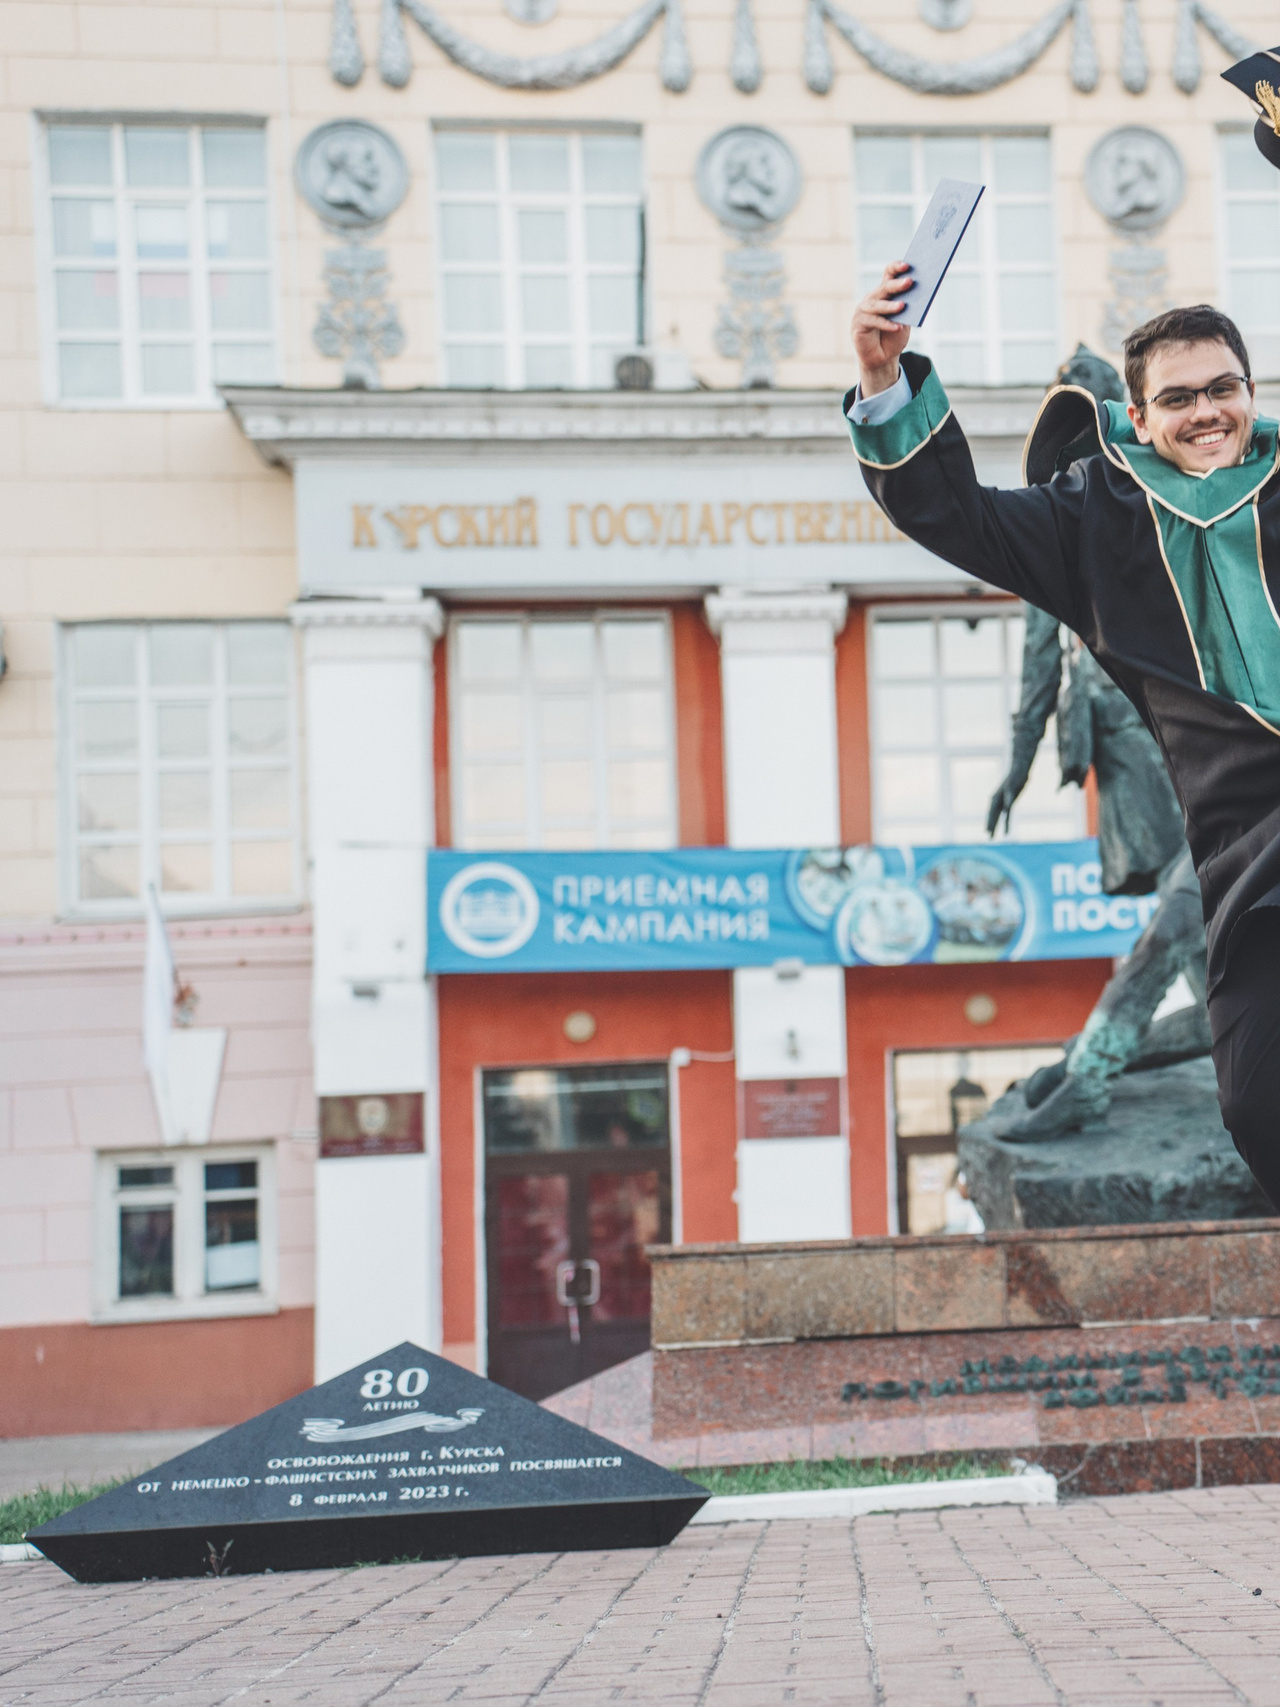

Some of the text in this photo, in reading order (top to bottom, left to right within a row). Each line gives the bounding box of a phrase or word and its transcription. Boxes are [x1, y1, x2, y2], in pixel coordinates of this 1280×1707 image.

[353, 496, 910, 548] КУРСКИЙ ГОСУДАРСТВЕНН
[1051, 861, 1103, 896] ПО
[553, 909, 770, 943] КАМПАНИЯ
[1052, 895, 1160, 932] ПОСТ
[360, 1367, 429, 1398] 80
[362, 1399, 420, 1412] ЛЕТИЮ
[267, 1452, 410, 1469] ОСВОБОЖДЕНИЯ
[137, 1481, 162, 1494] ОТ
[388, 1462, 500, 1479] ЗАХВАТЧИКОВ
[289, 1493, 303, 1507] 8
[314, 1490, 388, 1505] ФЕВРАЛЯ
[399, 1485, 450, 1501] 2023
